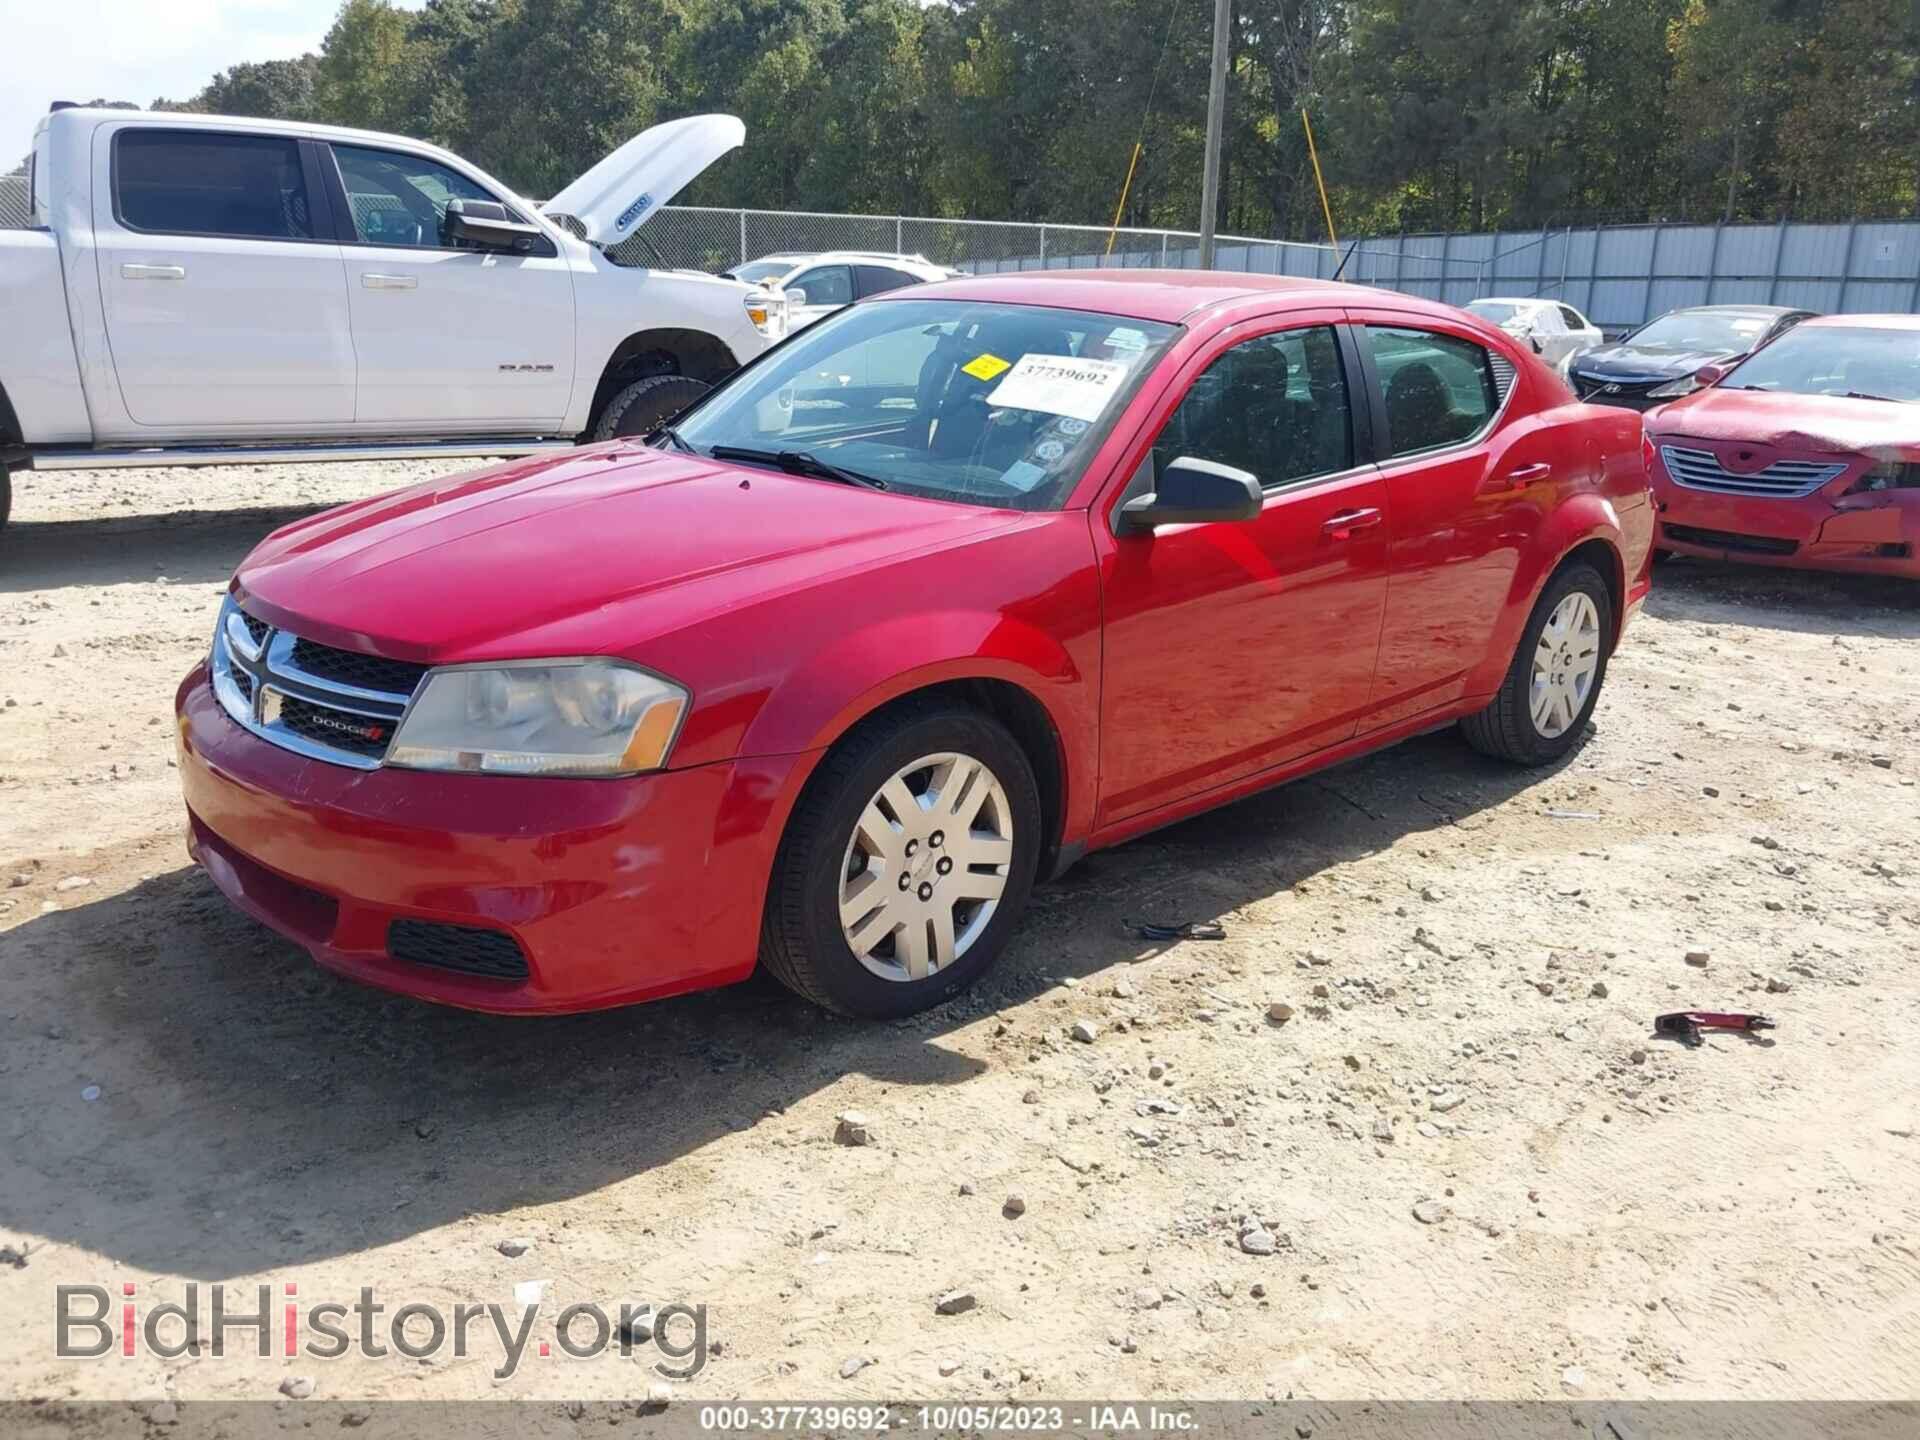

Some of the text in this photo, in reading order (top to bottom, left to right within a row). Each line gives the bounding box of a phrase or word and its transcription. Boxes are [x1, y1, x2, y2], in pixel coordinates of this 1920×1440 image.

[498, 364, 554, 373] RAM
[1021, 364, 1108, 385] 37739692
[312, 715, 372, 737] DODGE
